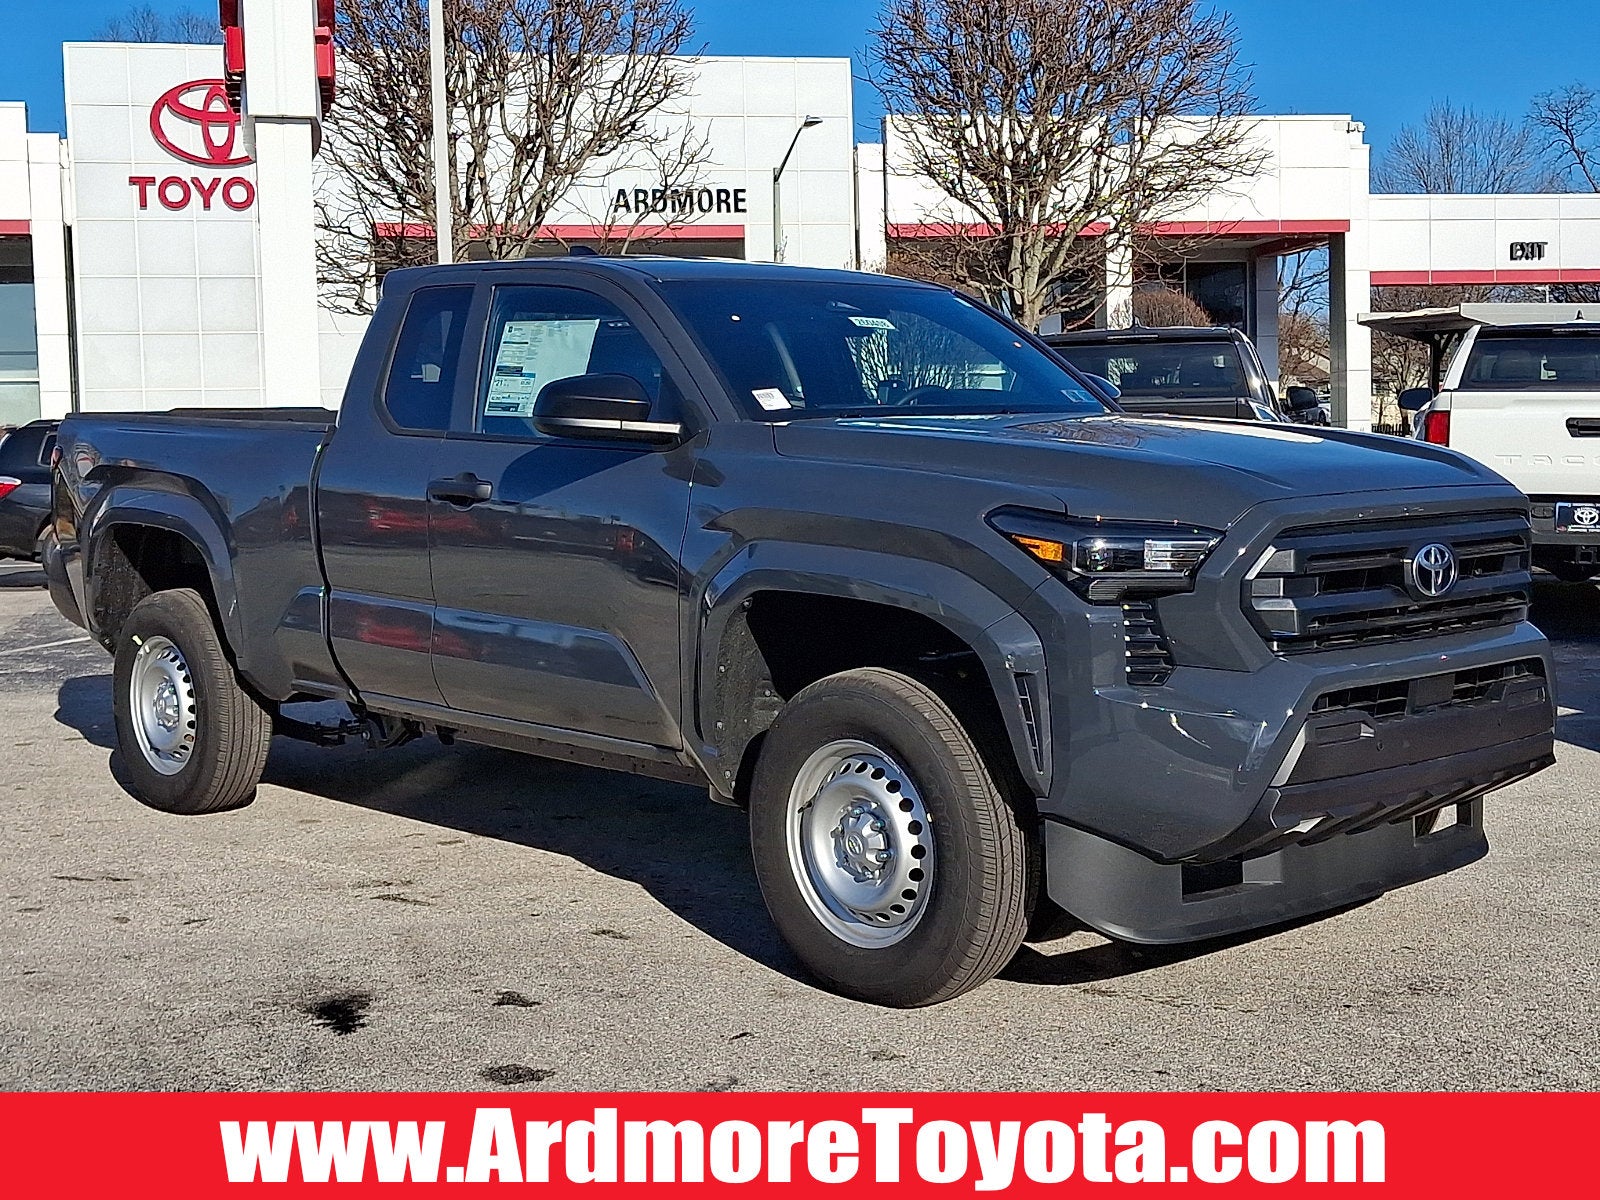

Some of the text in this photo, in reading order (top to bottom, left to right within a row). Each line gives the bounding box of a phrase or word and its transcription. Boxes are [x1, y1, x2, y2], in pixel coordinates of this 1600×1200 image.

[128, 176, 257, 211] TOYO
[613, 188, 747, 213] ARDMORE
[1509, 241, 1548, 261] EXIT
